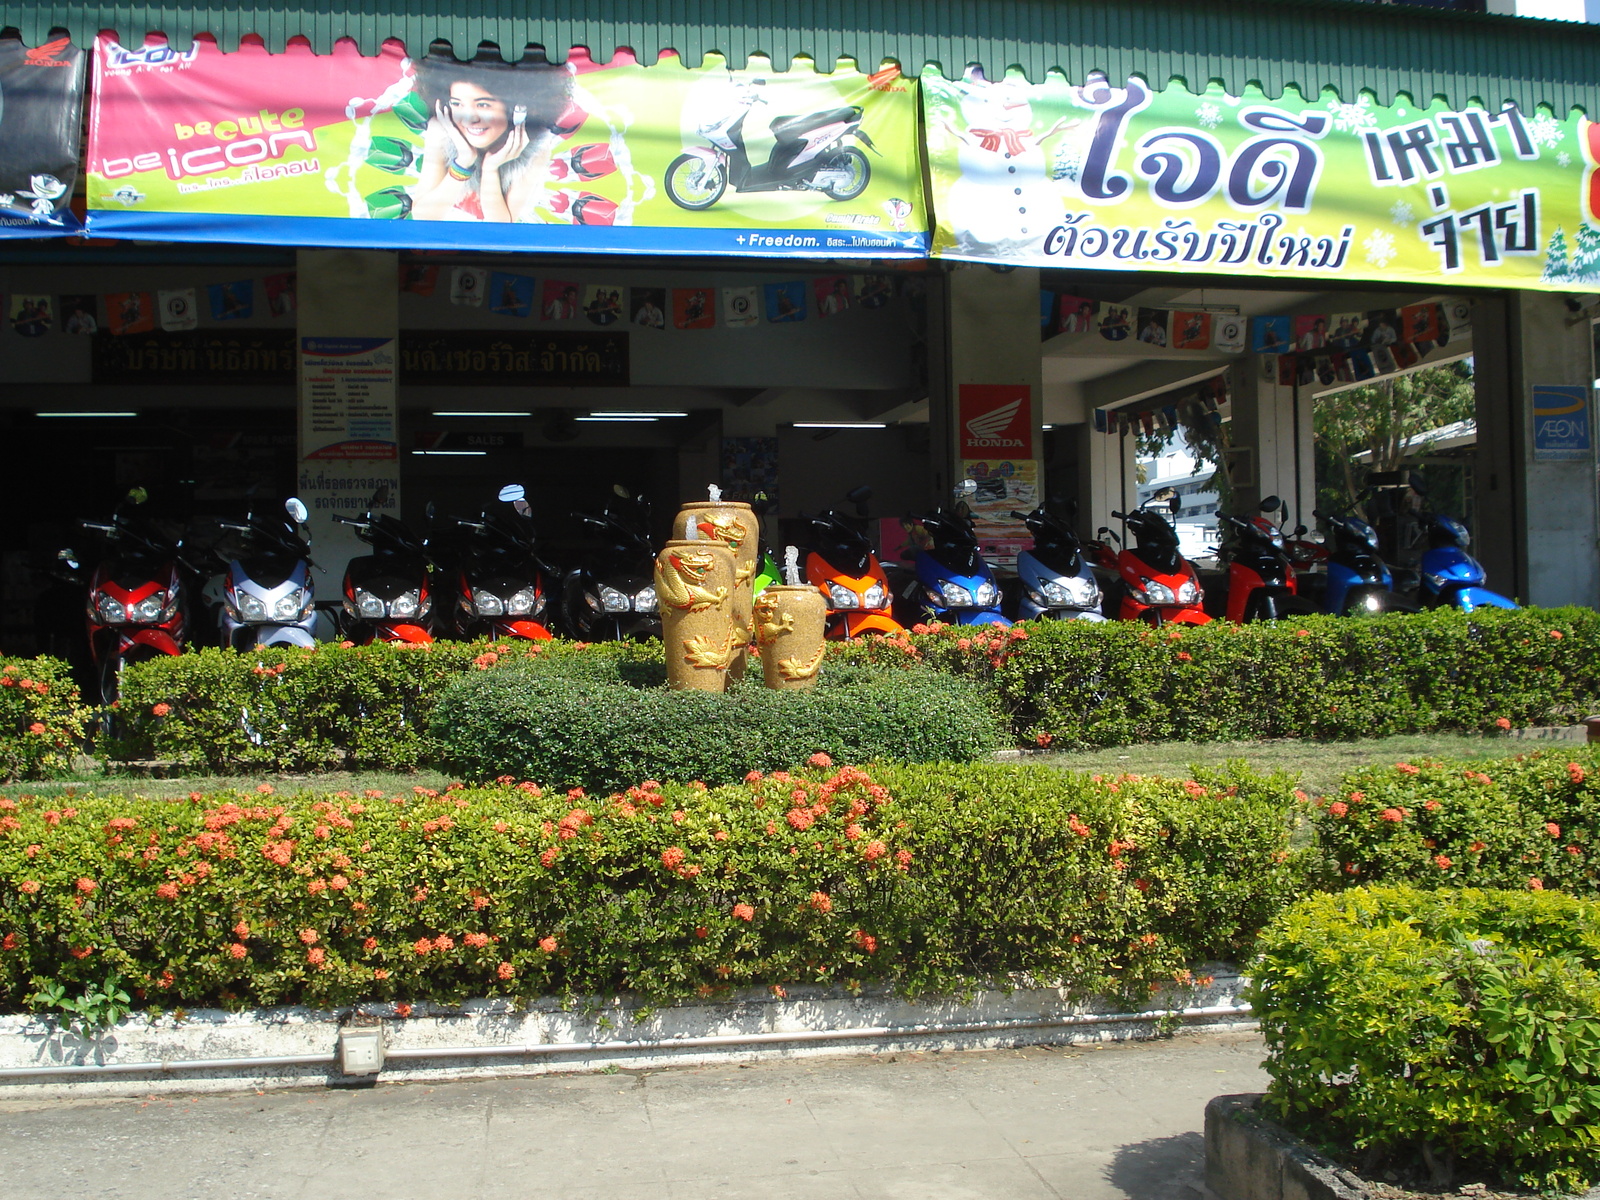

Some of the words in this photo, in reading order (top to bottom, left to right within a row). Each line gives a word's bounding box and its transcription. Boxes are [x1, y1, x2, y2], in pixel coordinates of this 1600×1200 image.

[24, 59, 72, 68] HONDA
[867, 85, 908, 93] HONDA
[213, 107, 305, 141] cute
[102, 151, 163, 177] be
[167, 129, 314, 178] icon
[1078, 73, 1327, 208] ใจดี
[1365, 106, 1535, 182] เหมา
[748, 233, 820, 247] Freedom.
[1043, 213, 1353, 269] ต้อนรับปีใหม่
[1422, 186, 1538, 270] จ่าย
[125, 339, 197, 371] บริษัท
[541, 342, 601, 373] จำกัด
[467, 435, 505, 445] SALES
[966, 438, 1025, 448] HONDA
